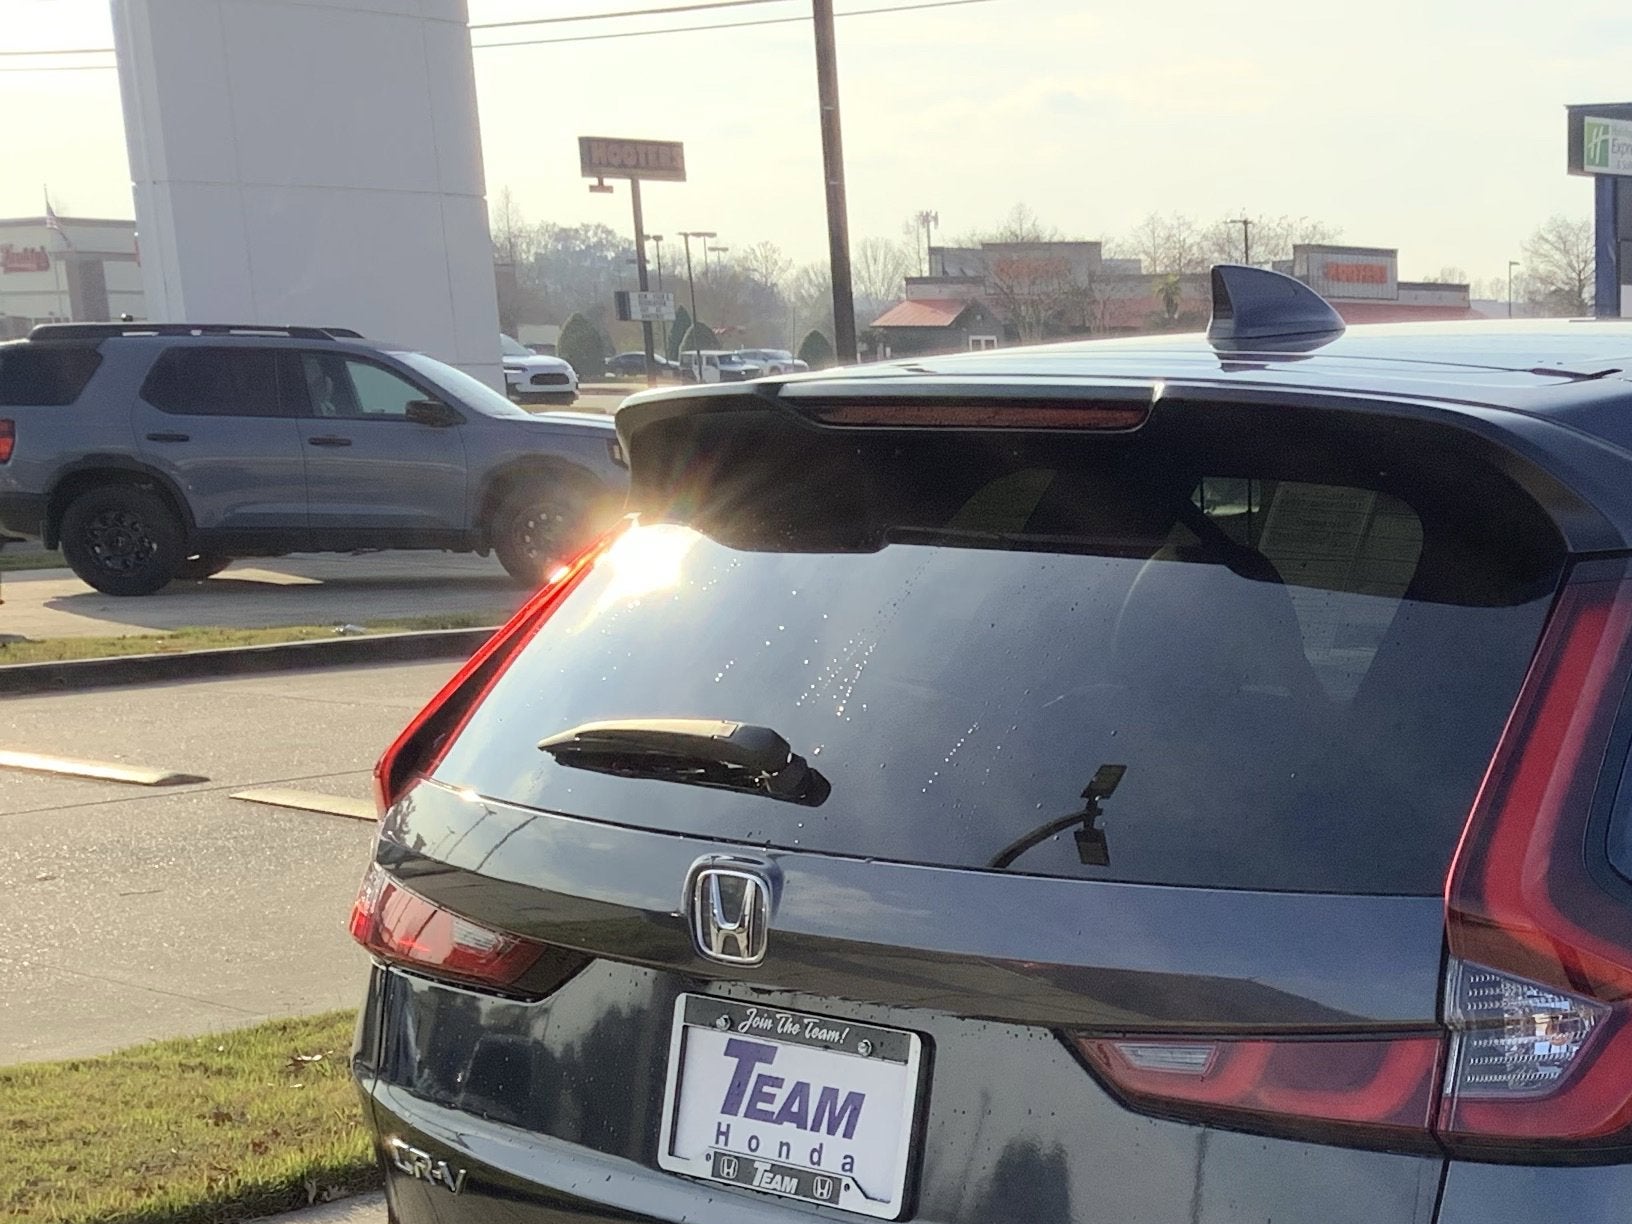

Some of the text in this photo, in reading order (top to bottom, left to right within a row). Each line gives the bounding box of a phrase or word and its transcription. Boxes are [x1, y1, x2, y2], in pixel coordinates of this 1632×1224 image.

[738, 1008, 850, 1044] Join The Team!
[720, 1037, 866, 1140] TEAM
[715, 1122, 855, 1173] Honda
[752, 1160, 799, 1194] TEAM
